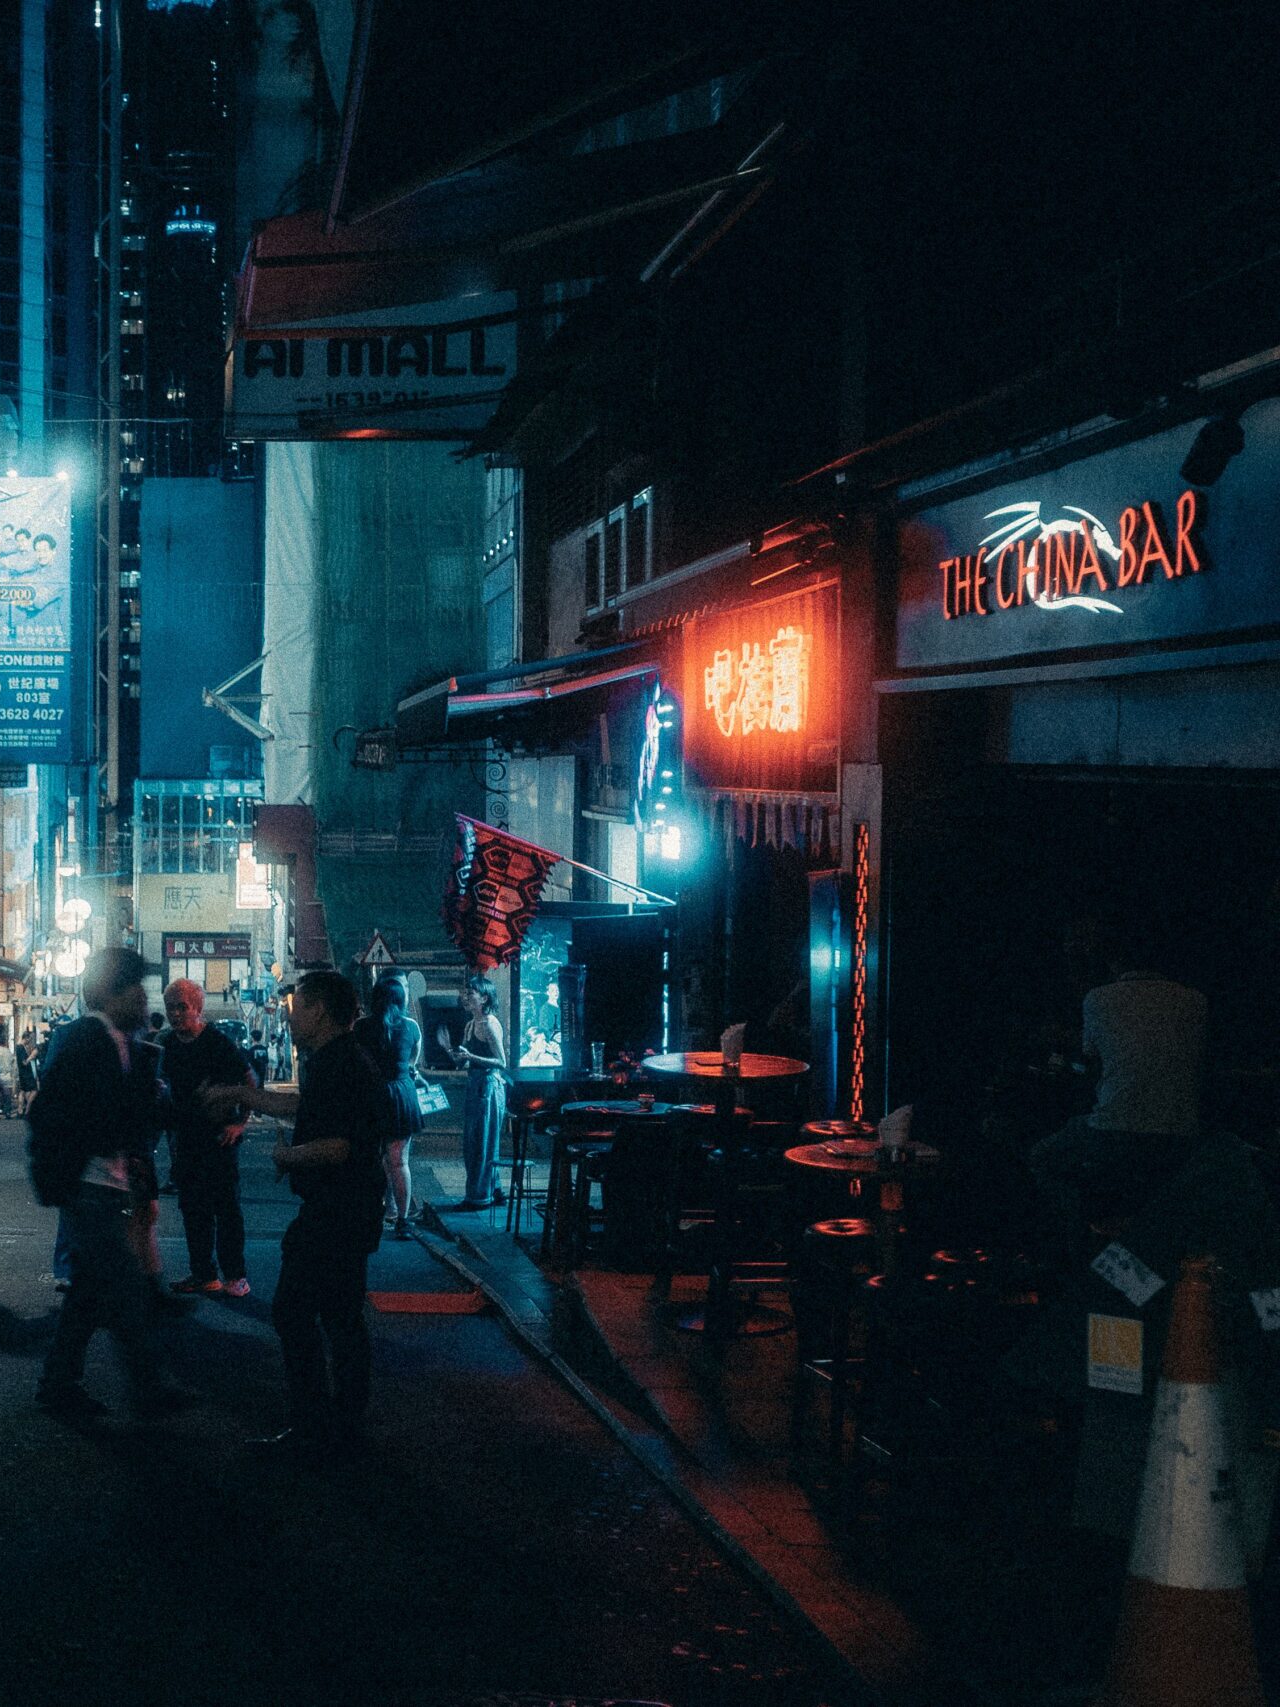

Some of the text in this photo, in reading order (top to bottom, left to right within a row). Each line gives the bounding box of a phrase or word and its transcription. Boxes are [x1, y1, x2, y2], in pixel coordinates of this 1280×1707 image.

[326, 327, 508, 378] MALL
[939, 489, 1201, 620] THE CHINA BAR
[0, 708, 64, 720] 3628 4027
